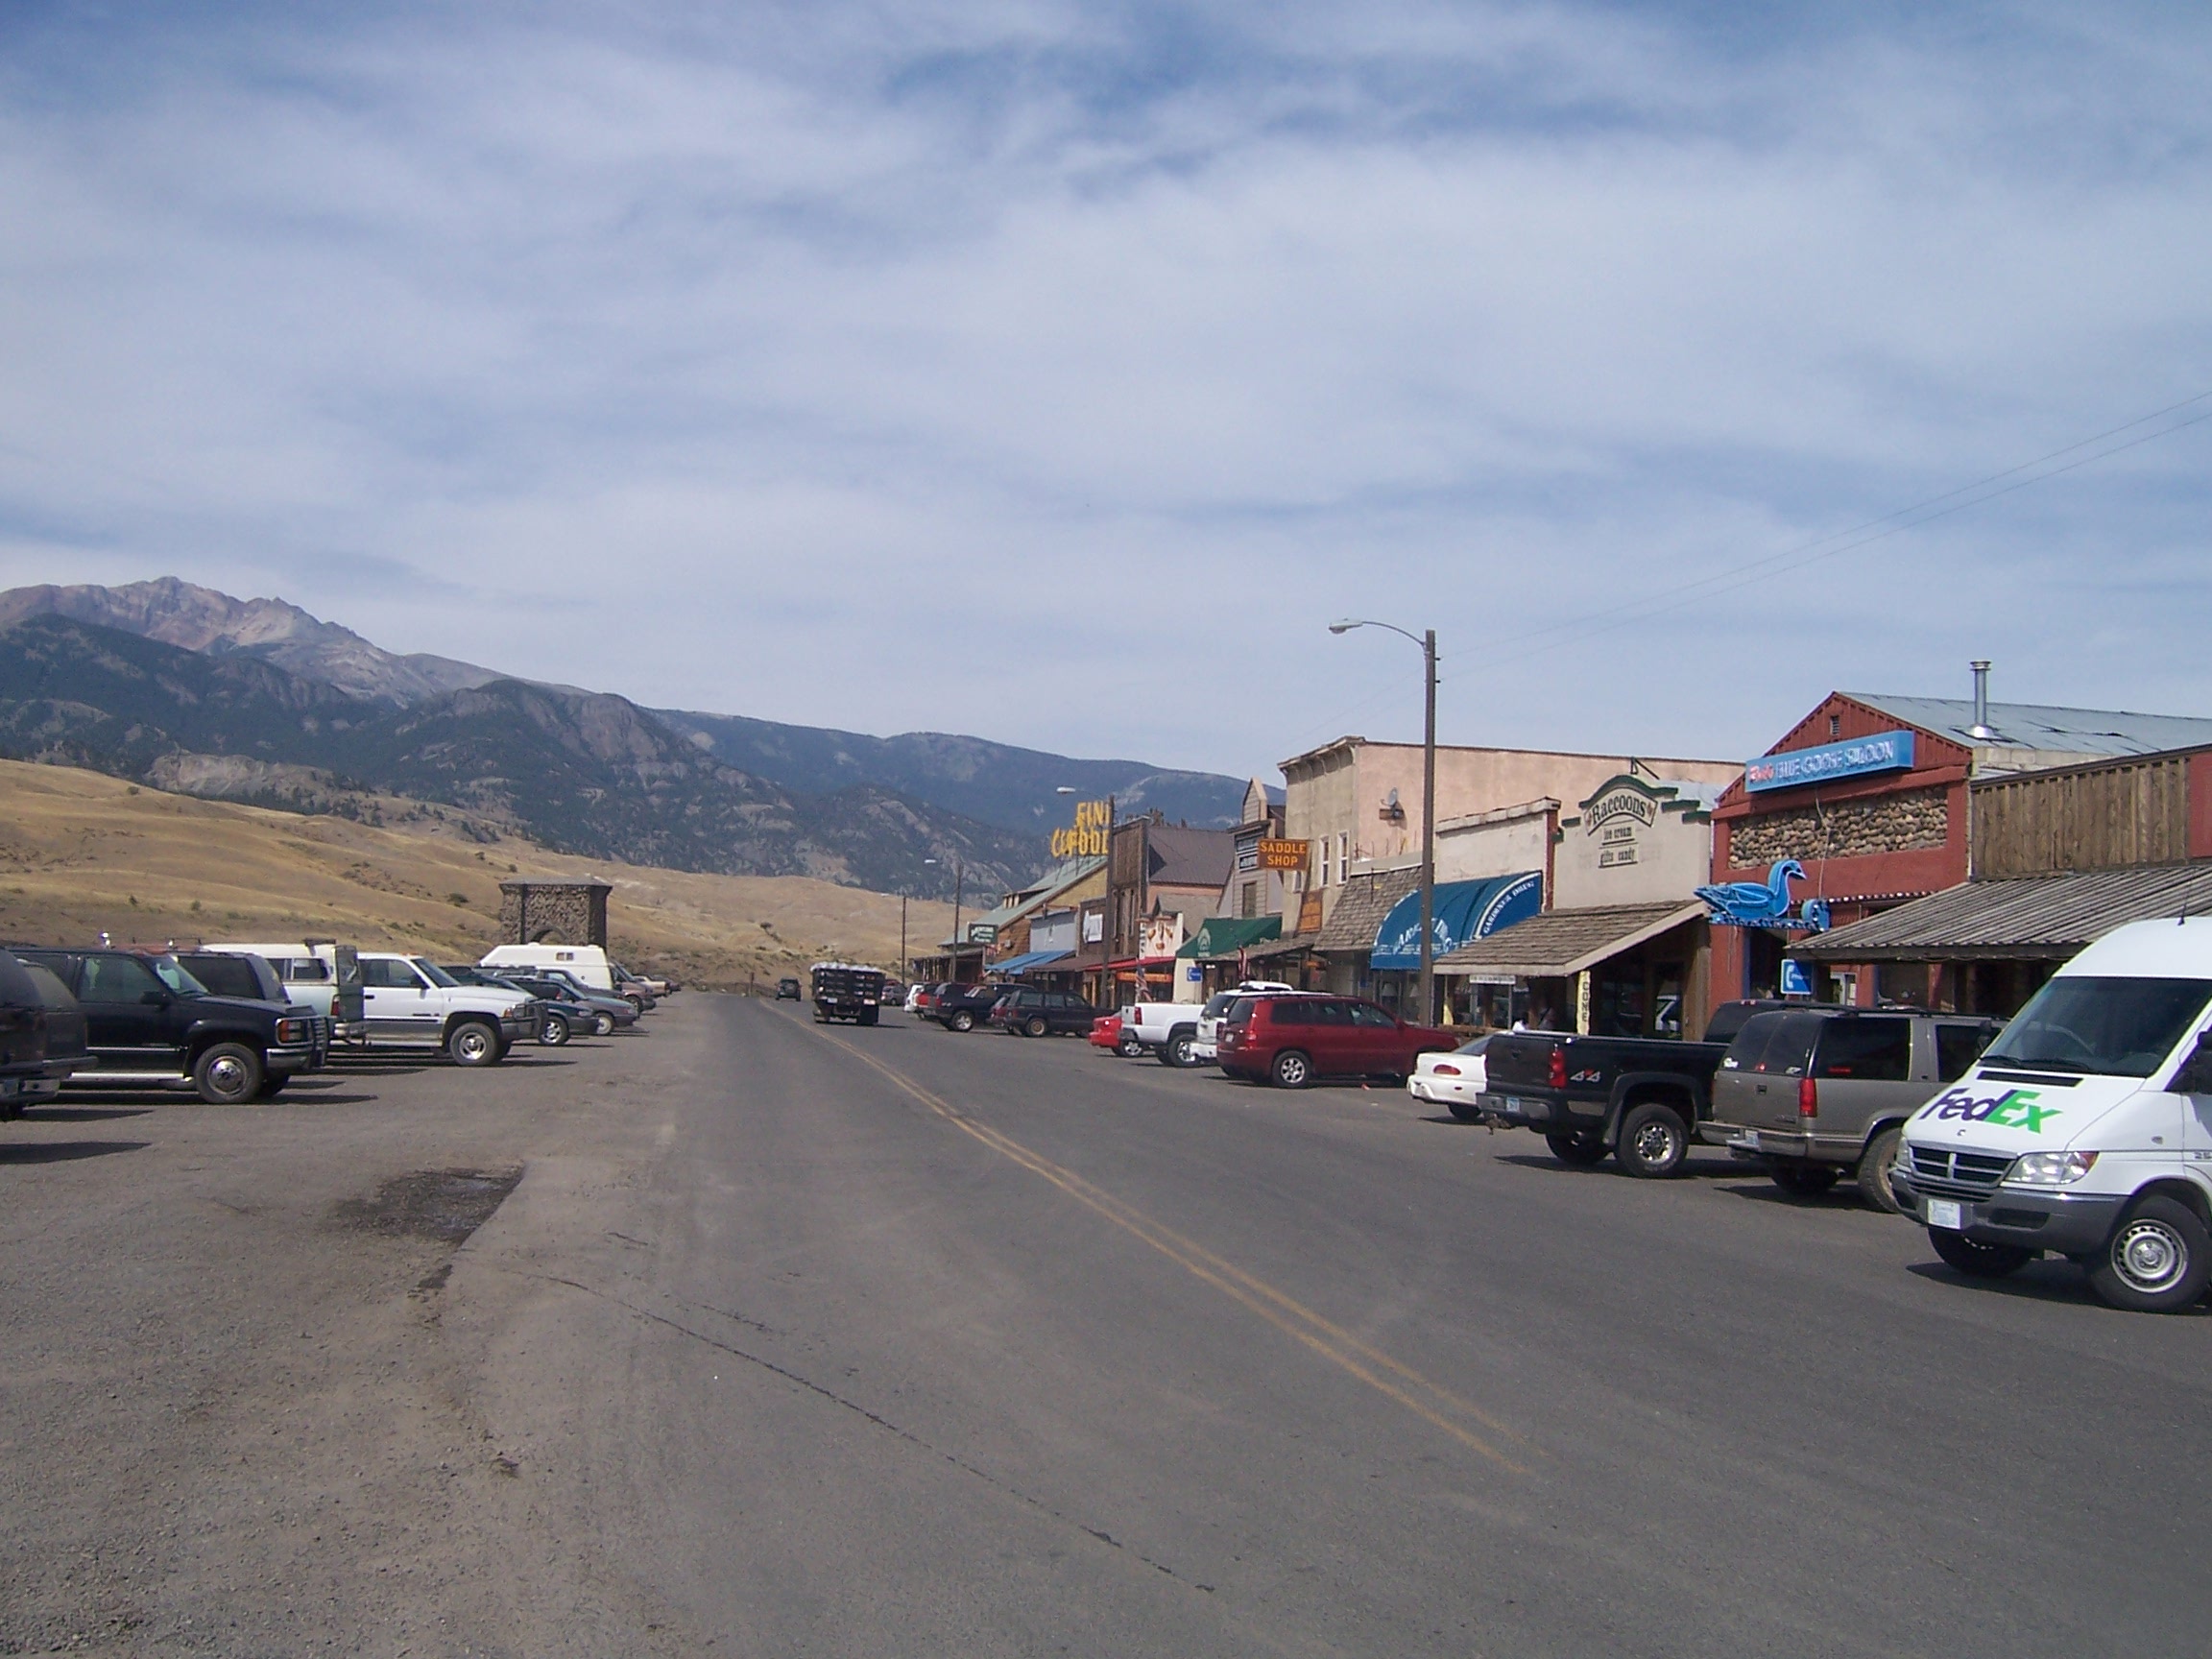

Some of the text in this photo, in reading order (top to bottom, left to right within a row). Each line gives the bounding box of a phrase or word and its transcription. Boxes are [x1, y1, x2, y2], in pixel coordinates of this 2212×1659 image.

[1776, 757, 1800, 778] BLUE
[1801, 749, 1843, 774] GOOSE
[1843, 740, 1893, 767] SALOON
[1592, 795, 1646, 825] Raccoons
[1261, 842, 1306, 854] SADDLE
[1267, 855, 1298, 866] SHOP
[1919, 1087, 2063, 1134] FedEx
